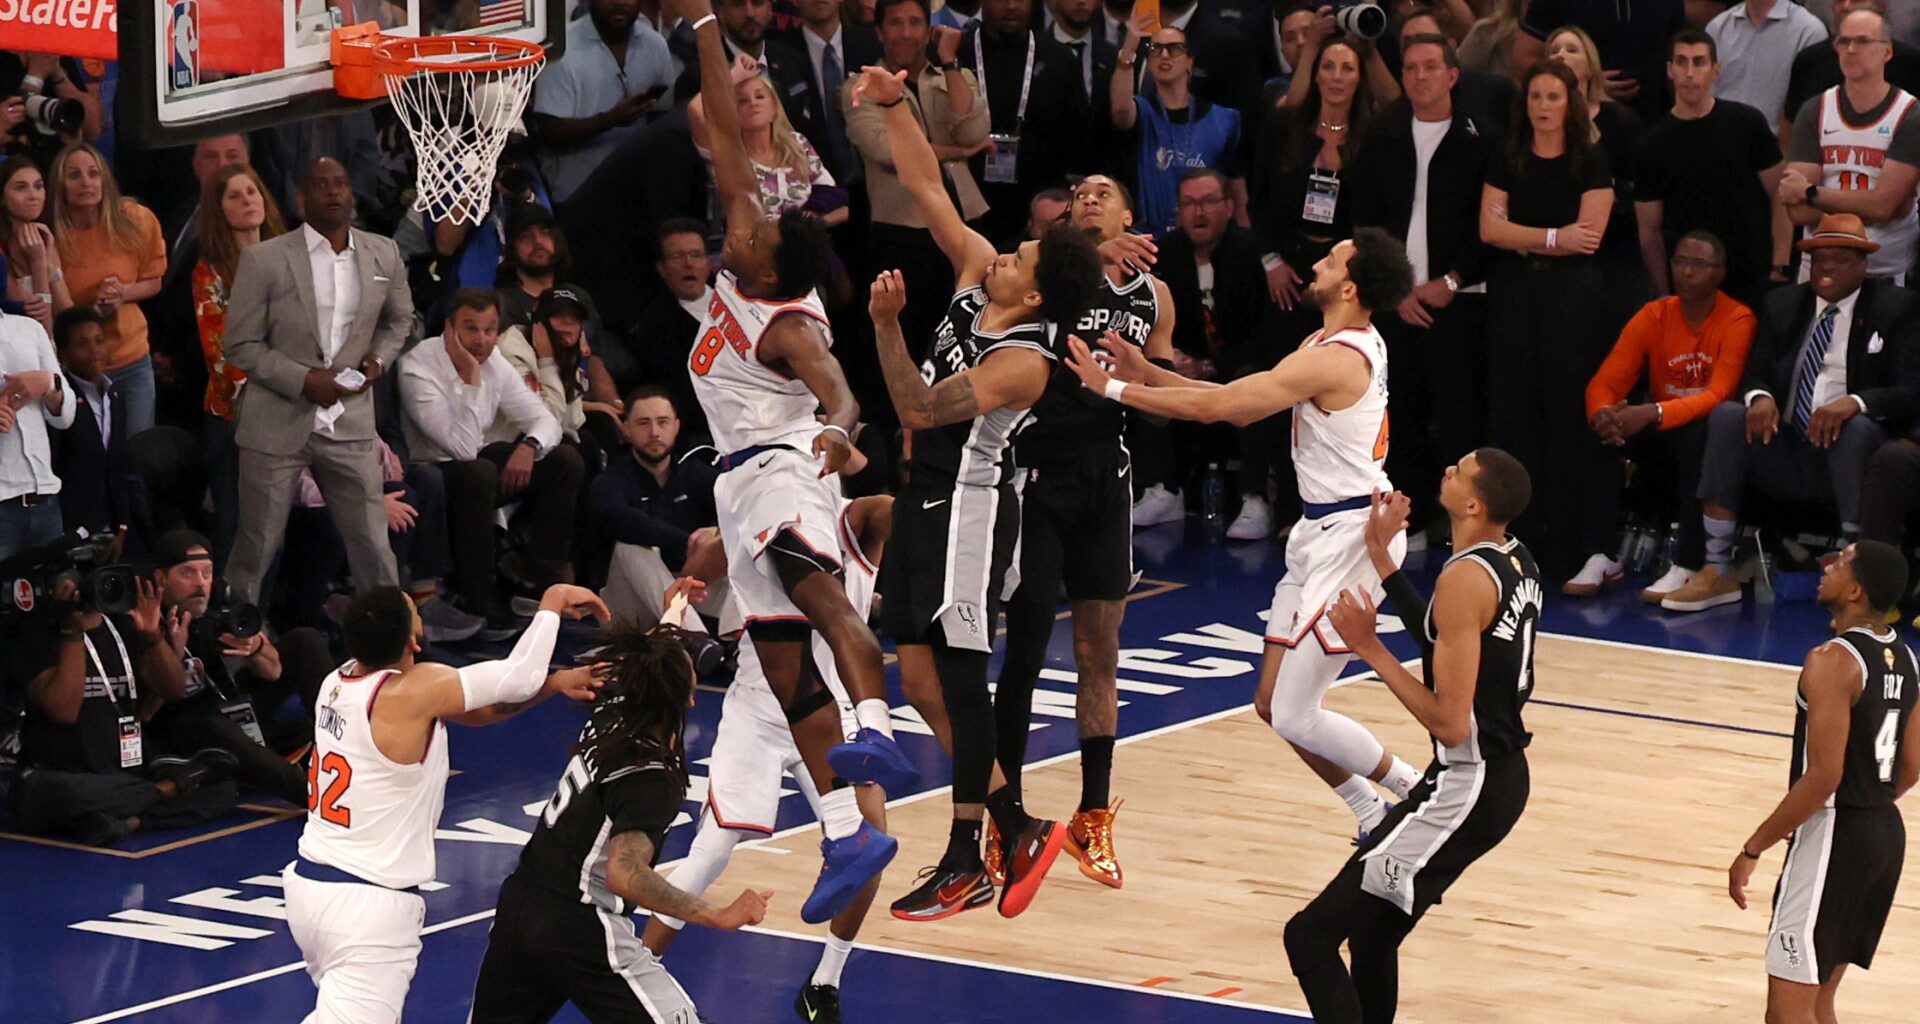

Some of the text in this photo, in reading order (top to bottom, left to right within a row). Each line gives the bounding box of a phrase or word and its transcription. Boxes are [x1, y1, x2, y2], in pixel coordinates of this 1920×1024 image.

[690, 326, 725, 377] 8
[1077, 309, 1151, 346] SPURS
[1518, 617, 1534, 692] 1
[1883, 673, 1904, 700] FOX
[318, 704, 346, 741] TOWNS
[1874, 708, 1901, 782] 4
[307, 742, 352, 828] 32
[544, 753, 592, 829] 5
